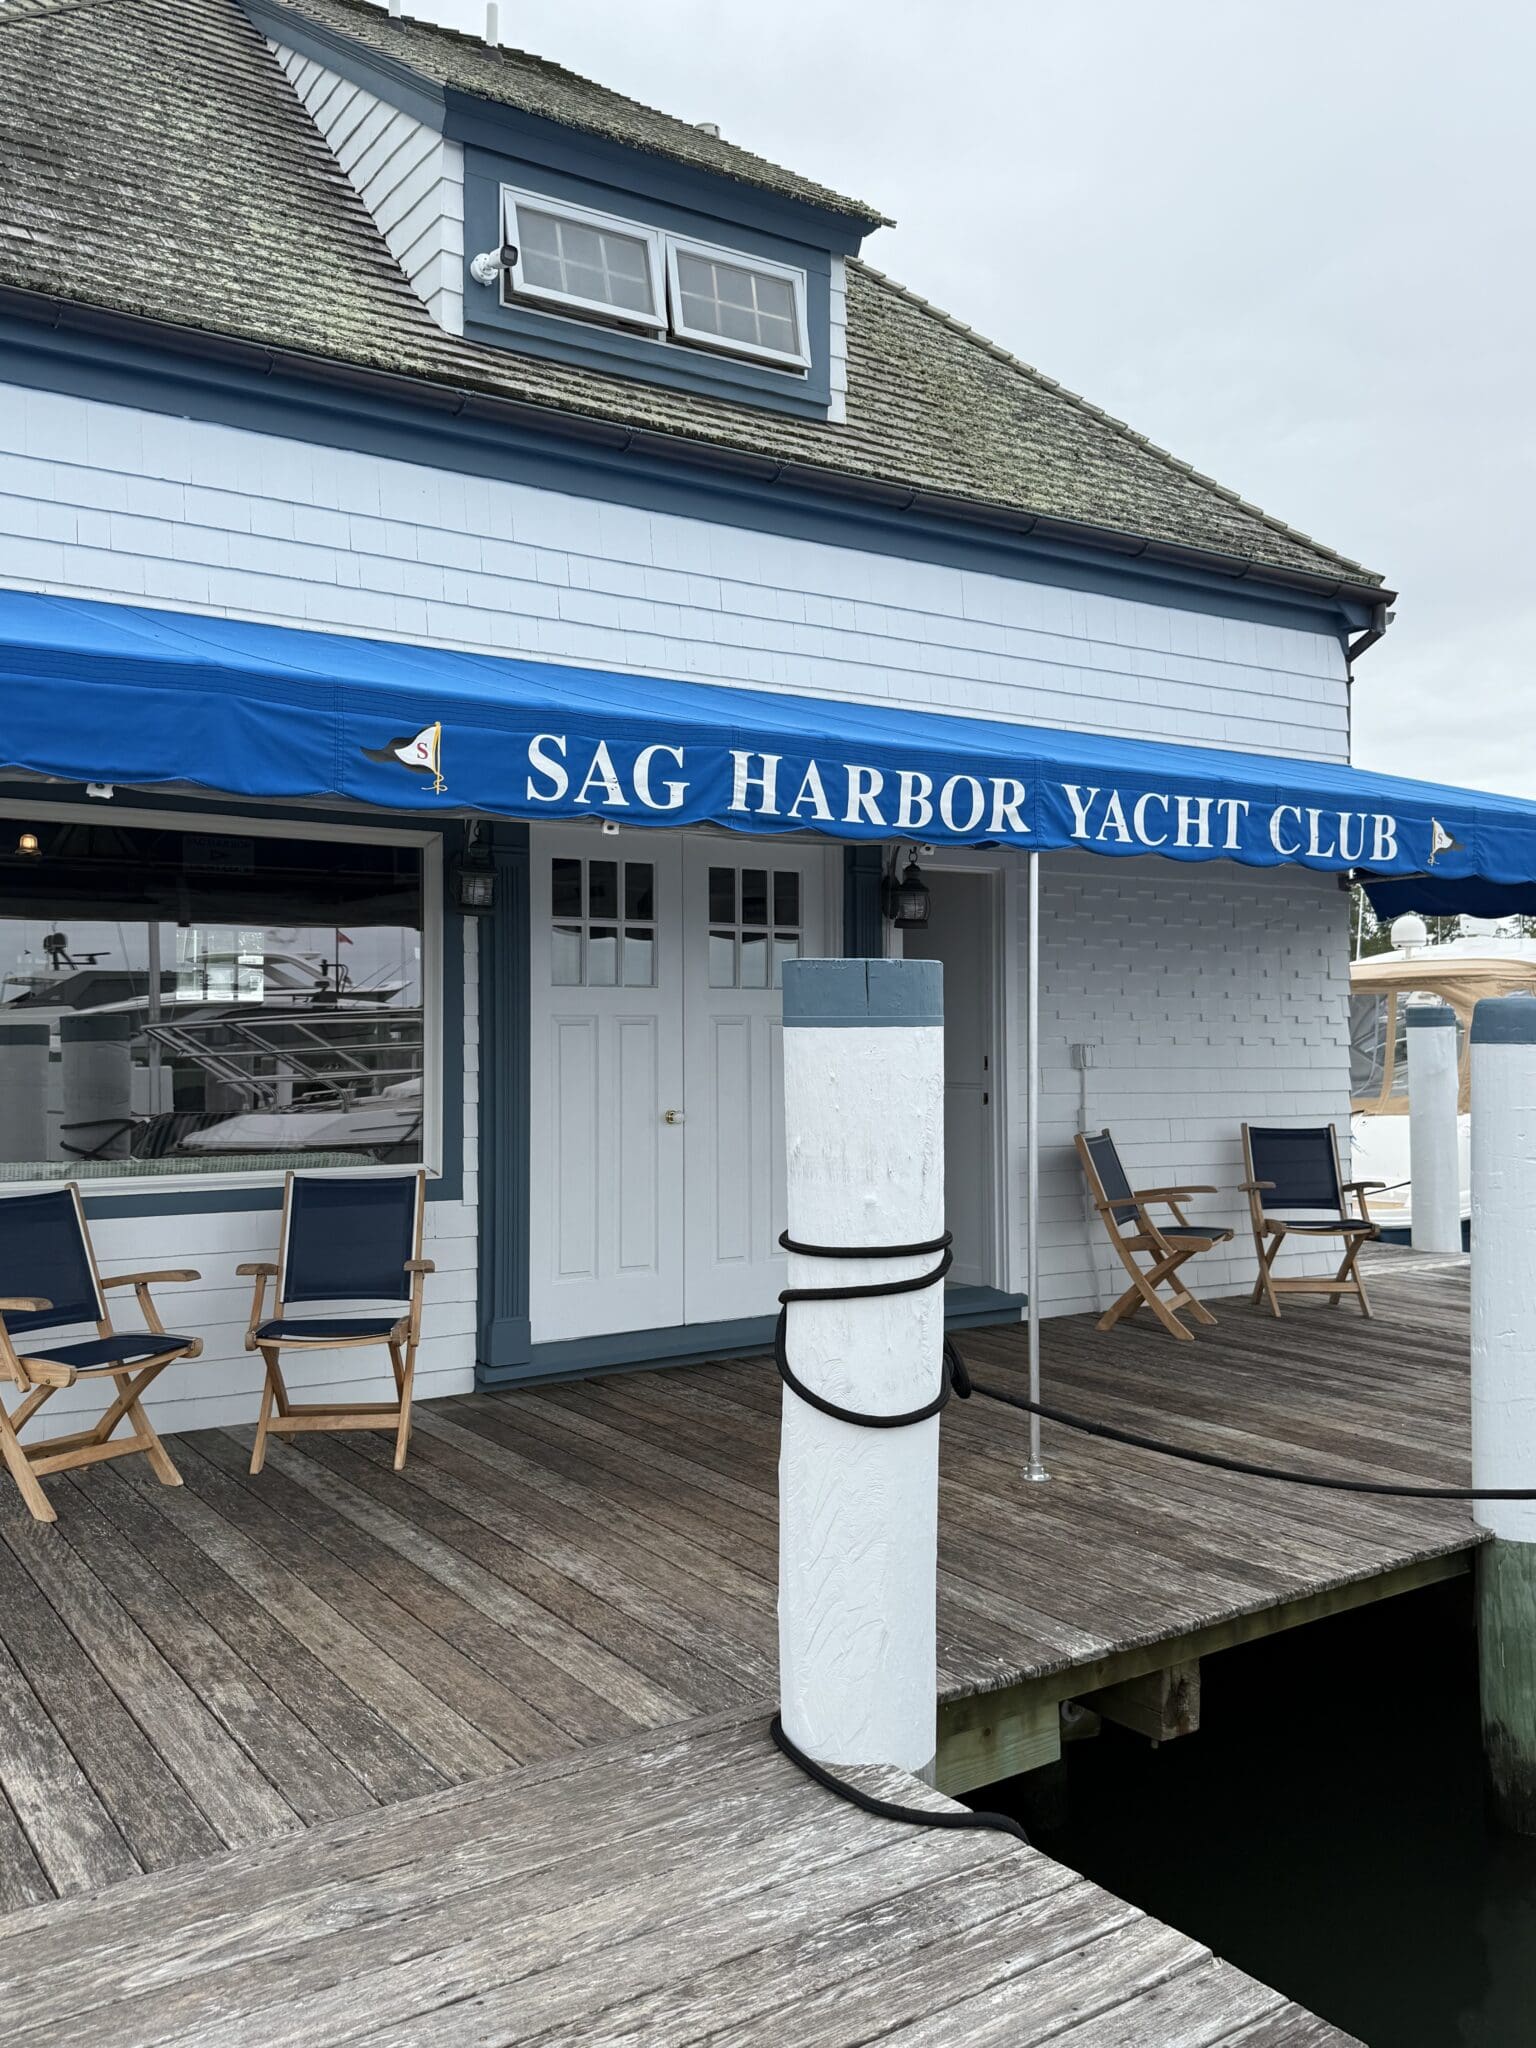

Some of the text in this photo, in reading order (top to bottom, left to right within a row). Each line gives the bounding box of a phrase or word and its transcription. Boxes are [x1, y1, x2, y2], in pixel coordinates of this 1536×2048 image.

[416, 742, 429, 760] S
[526, 733, 1399, 861] SAG HARBOR YACHT CLUB
